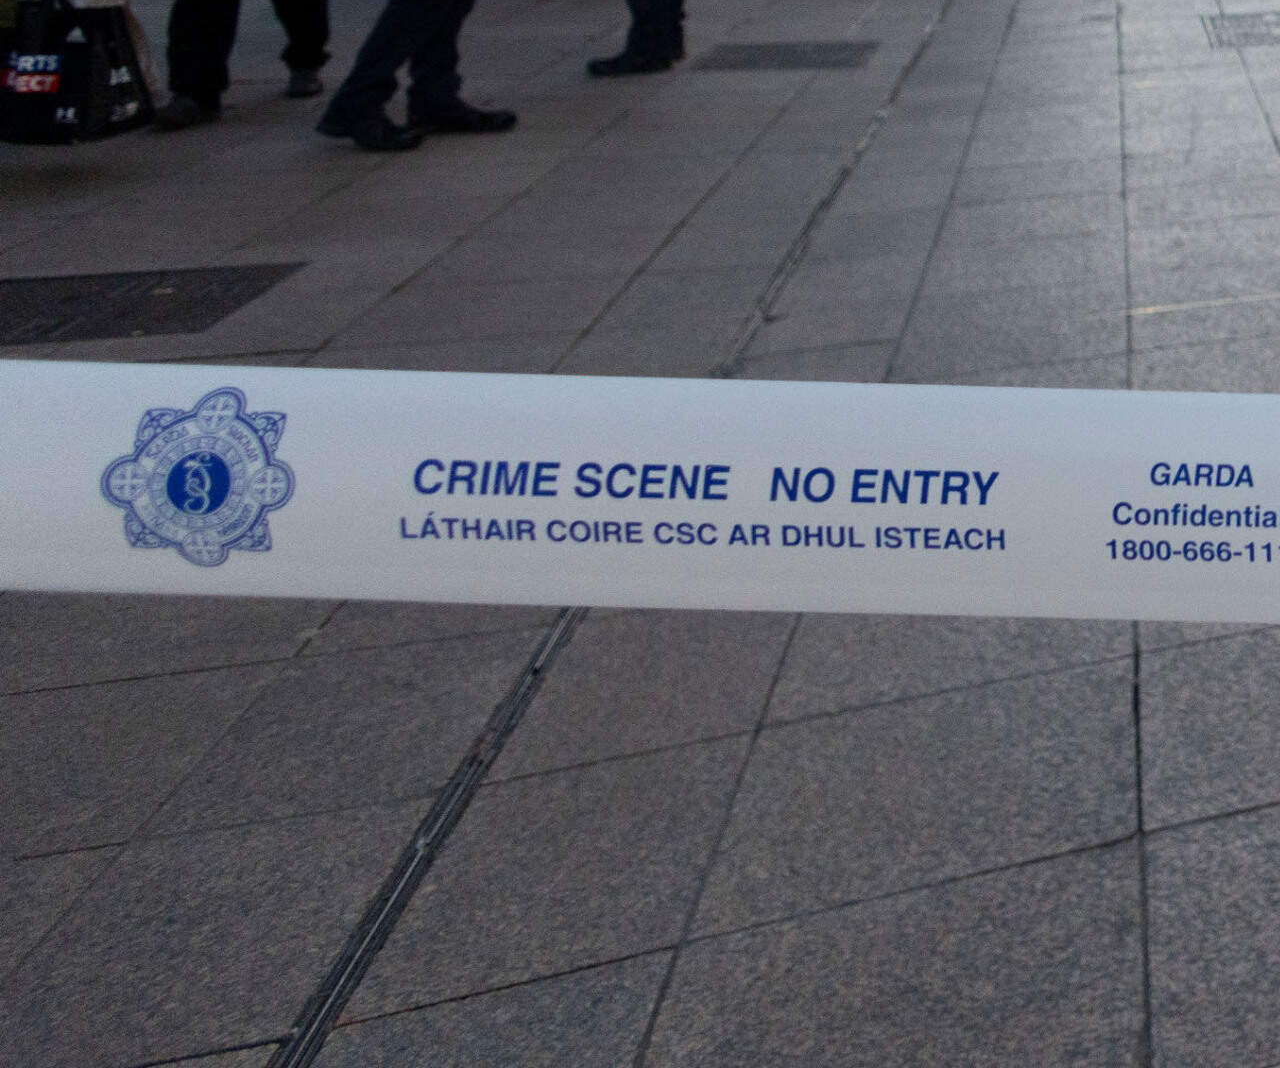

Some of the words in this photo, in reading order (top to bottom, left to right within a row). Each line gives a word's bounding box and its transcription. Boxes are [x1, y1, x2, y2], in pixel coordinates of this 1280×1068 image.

[412, 458, 561, 497] CRIME
[574, 462, 731, 501] SCENE
[769, 467, 836, 504] NO
[850, 468, 1000, 506] ENTRY
[1150, 462, 1254, 488] GARDA
[399, 511, 536, 541] LÁTHAIR
[546, 519, 644, 544] COIRE
[653, 522, 718, 546] CSC
[728, 524, 770, 546] AR
[781, 524, 866, 548] DHUL
[875, 526, 1006, 551] ISTEACH
